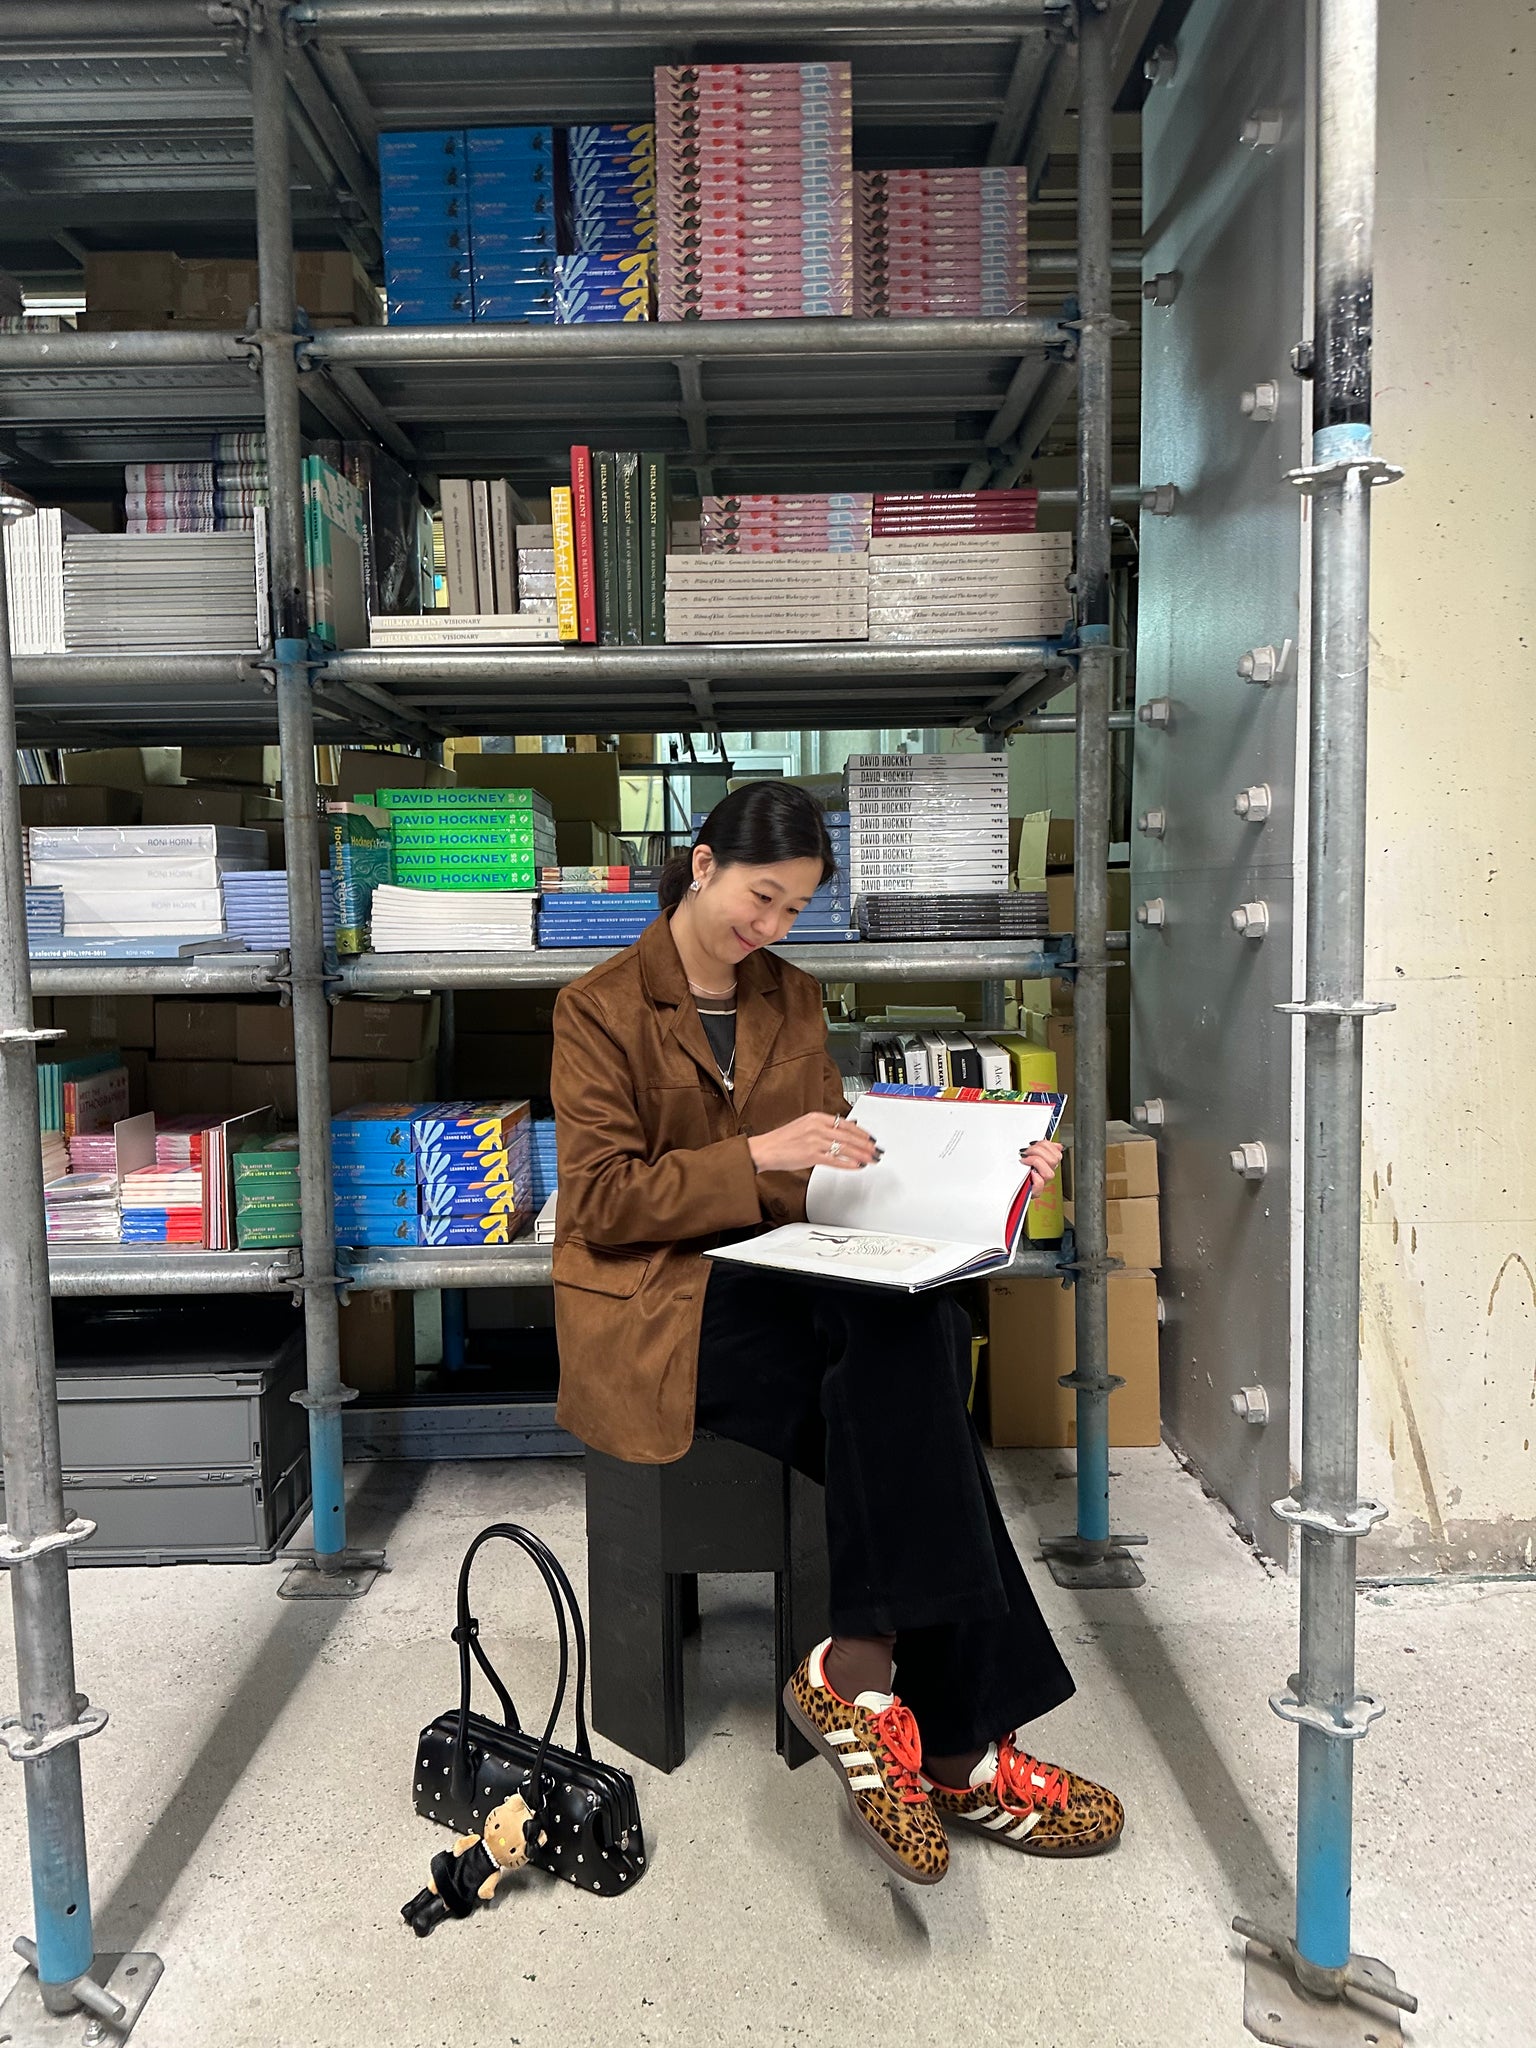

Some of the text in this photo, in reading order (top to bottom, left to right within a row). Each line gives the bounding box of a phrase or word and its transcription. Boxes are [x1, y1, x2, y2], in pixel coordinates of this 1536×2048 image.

[577, 457, 585, 484] HILMA
[578, 485, 585, 496] AF
[601, 492, 607, 500] AF
[650, 492, 656, 501] AF
[554, 493, 570, 550] HILMA
[258, 552, 264, 565] Wo
[557, 553, 569, 573] AF
[258, 567, 265, 576] Es
[581, 554, 590, 599] BELIEVING
[558, 576, 575, 625] KLINT
[860, 756, 879, 767] DAVID
[882, 756, 913, 767] HOCKNEY
[861, 772, 881, 782] DAVID
[883, 771, 913, 782] HOCKNEY
[859, 788, 879, 798] DAVID
[882, 787, 912, 798] HOCKNEY
[392, 793, 515, 804] DAVID HOCKNEY 25
[859, 803, 879, 814] DAVID
[882, 802, 912, 814] HOCKNEY
[393, 814, 516, 824] DAVID HOCKNEY 25
[860, 819, 880, 829] DAVID
[883, 818, 913, 829] HOCKNEY
[169, 838, 193, 846] HORN
[351, 835, 375, 850] Hockney's
[394, 833, 517, 844] DAVID HOCKNEY 25
[860, 834, 880, 845] DAVID
[883, 833, 913, 844] HOCKNEY
[395, 853, 517, 864] DAVID HOCKNEY 25
[861, 849, 880, 860] DAVID
[883, 849, 913, 860] HOCKNEY
[334, 826, 348, 924] Hockney's Pictures
[861, 865, 881, 876] DAVID
[398, 872, 518, 883] DAVID HOCKNEY 25
[861, 880, 881, 891] DAVID
[913, 1062, 921, 1081] Alex
[994, 1065, 1002, 1086] Alex
